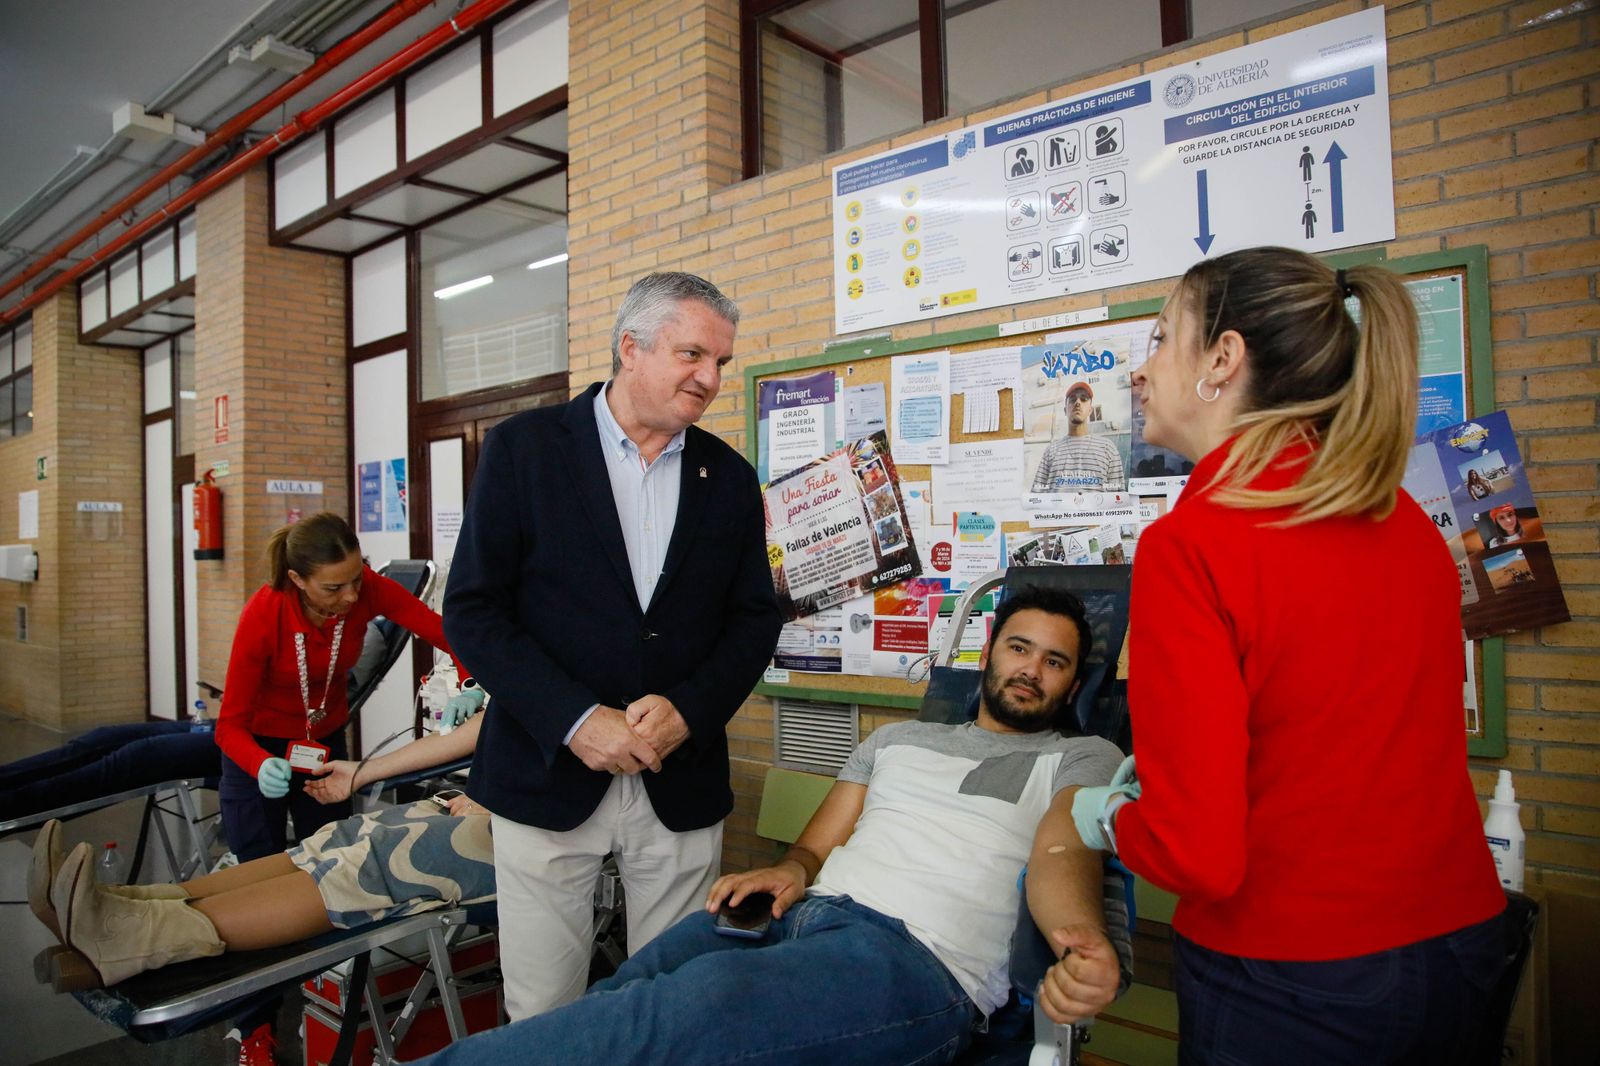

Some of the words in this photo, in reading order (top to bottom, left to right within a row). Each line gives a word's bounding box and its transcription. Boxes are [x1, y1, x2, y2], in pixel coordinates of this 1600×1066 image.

[1197, 59, 1269, 85] UNIVERSIDAD
[1198, 83, 1214, 96] DE
[1217, 69, 1270, 92] ALMERÍA
[997, 118, 1030, 134] BUENAS
[1032, 104, 1082, 125] PRÁCTICAS
[1084, 100, 1096, 110] DE
[1098, 88, 1136, 106] HIGIENE
[1186, 101, 1256, 126] CIRCULACIÓN
[1260, 97, 1274, 108] EN
[1277, 92, 1290, 104] EL
[1294, 77, 1348, 100] INTERIOR
[1231, 112, 1252, 126] DEL
[1254, 100, 1300, 120] EDIFICIO
[1178, 143, 1196, 154] POR
[1198, 136, 1230, 150] FAVOR,
[1230, 127, 1268, 142] CIRCULE
[1270, 120, 1289, 132] POR
[1292, 117, 1303, 128] LA
[1306, 106, 1351, 124] DERECHA
[1354, 104, 1360, 112] Y
[1183, 150, 1218, 164] GUARDE
[1220, 146, 1232, 156] LA
[1234, 136, 1282, 154] DISTANCIA
[1284, 132, 1296, 142] DE
[1299, 118, 1355, 138] SEGURIDAD
[776, 388, 812, 404] fremart
[800, 395, 830, 406] formación
[776, 418, 816, 428] INGENIERÍA
[783, 409, 808, 418] GRADO
[776, 426, 816, 436] INDUSTRIAL
[272, 482, 304, 492] AULA
[308, 482, 312, 492] 1
[782, 486, 802, 504] Una
[805, 469, 838, 496] Fiesta
[787, 503, 810, 524] para
[812, 488, 842, 505] soñar
[786, 536, 810, 553] Fallas
[812, 531, 822, 542] de
[823, 516, 862, 538] Valencia
